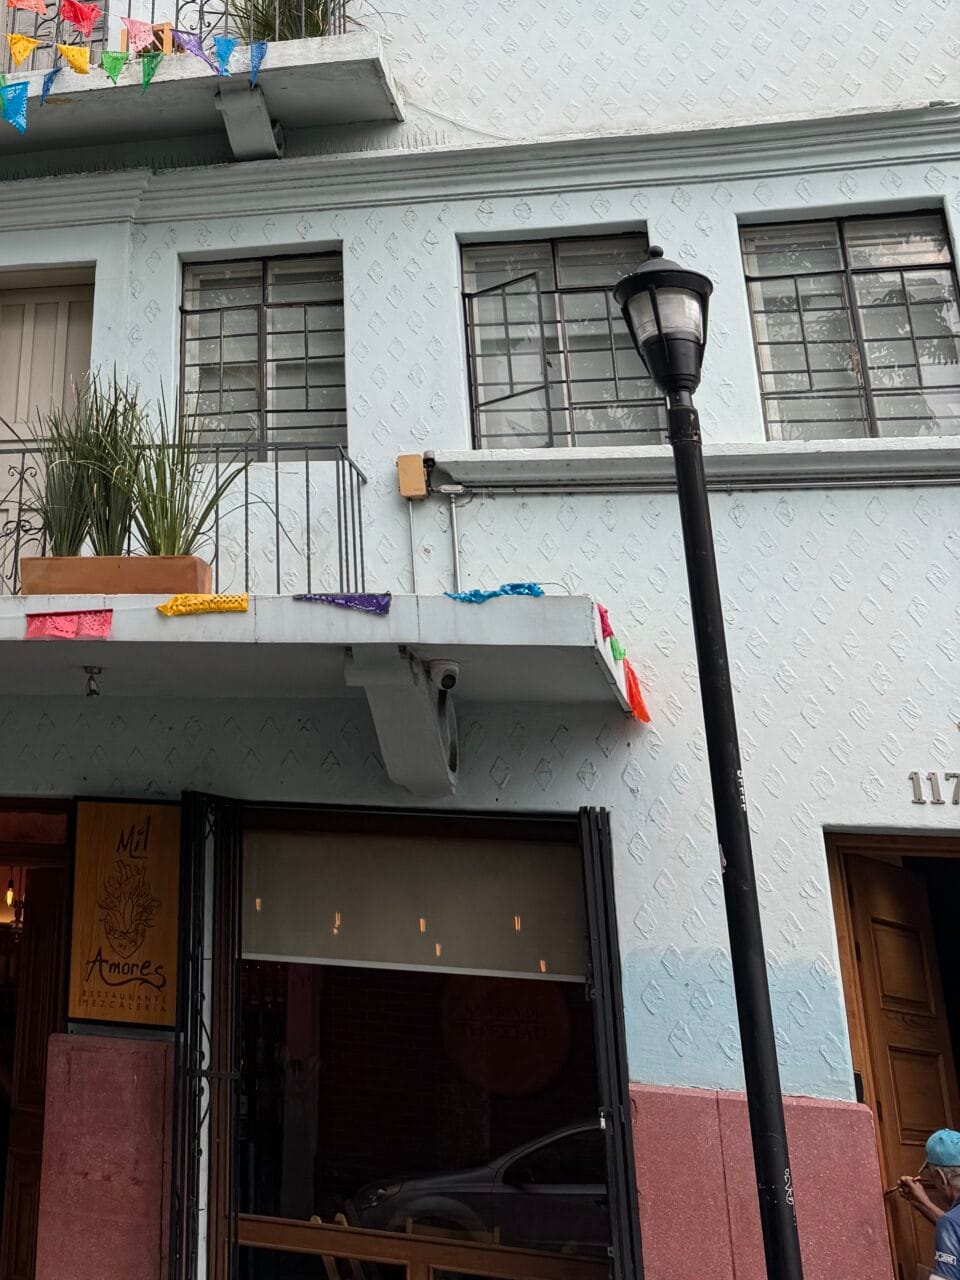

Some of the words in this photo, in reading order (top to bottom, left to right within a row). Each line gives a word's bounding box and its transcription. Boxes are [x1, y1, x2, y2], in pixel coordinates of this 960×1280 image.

[908, 771, 960, 805] 117
[116, 815, 151, 859] Mil
[85, 945, 167, 992] Amores
[81, 989, 166, 1004] RESTAURANTE
